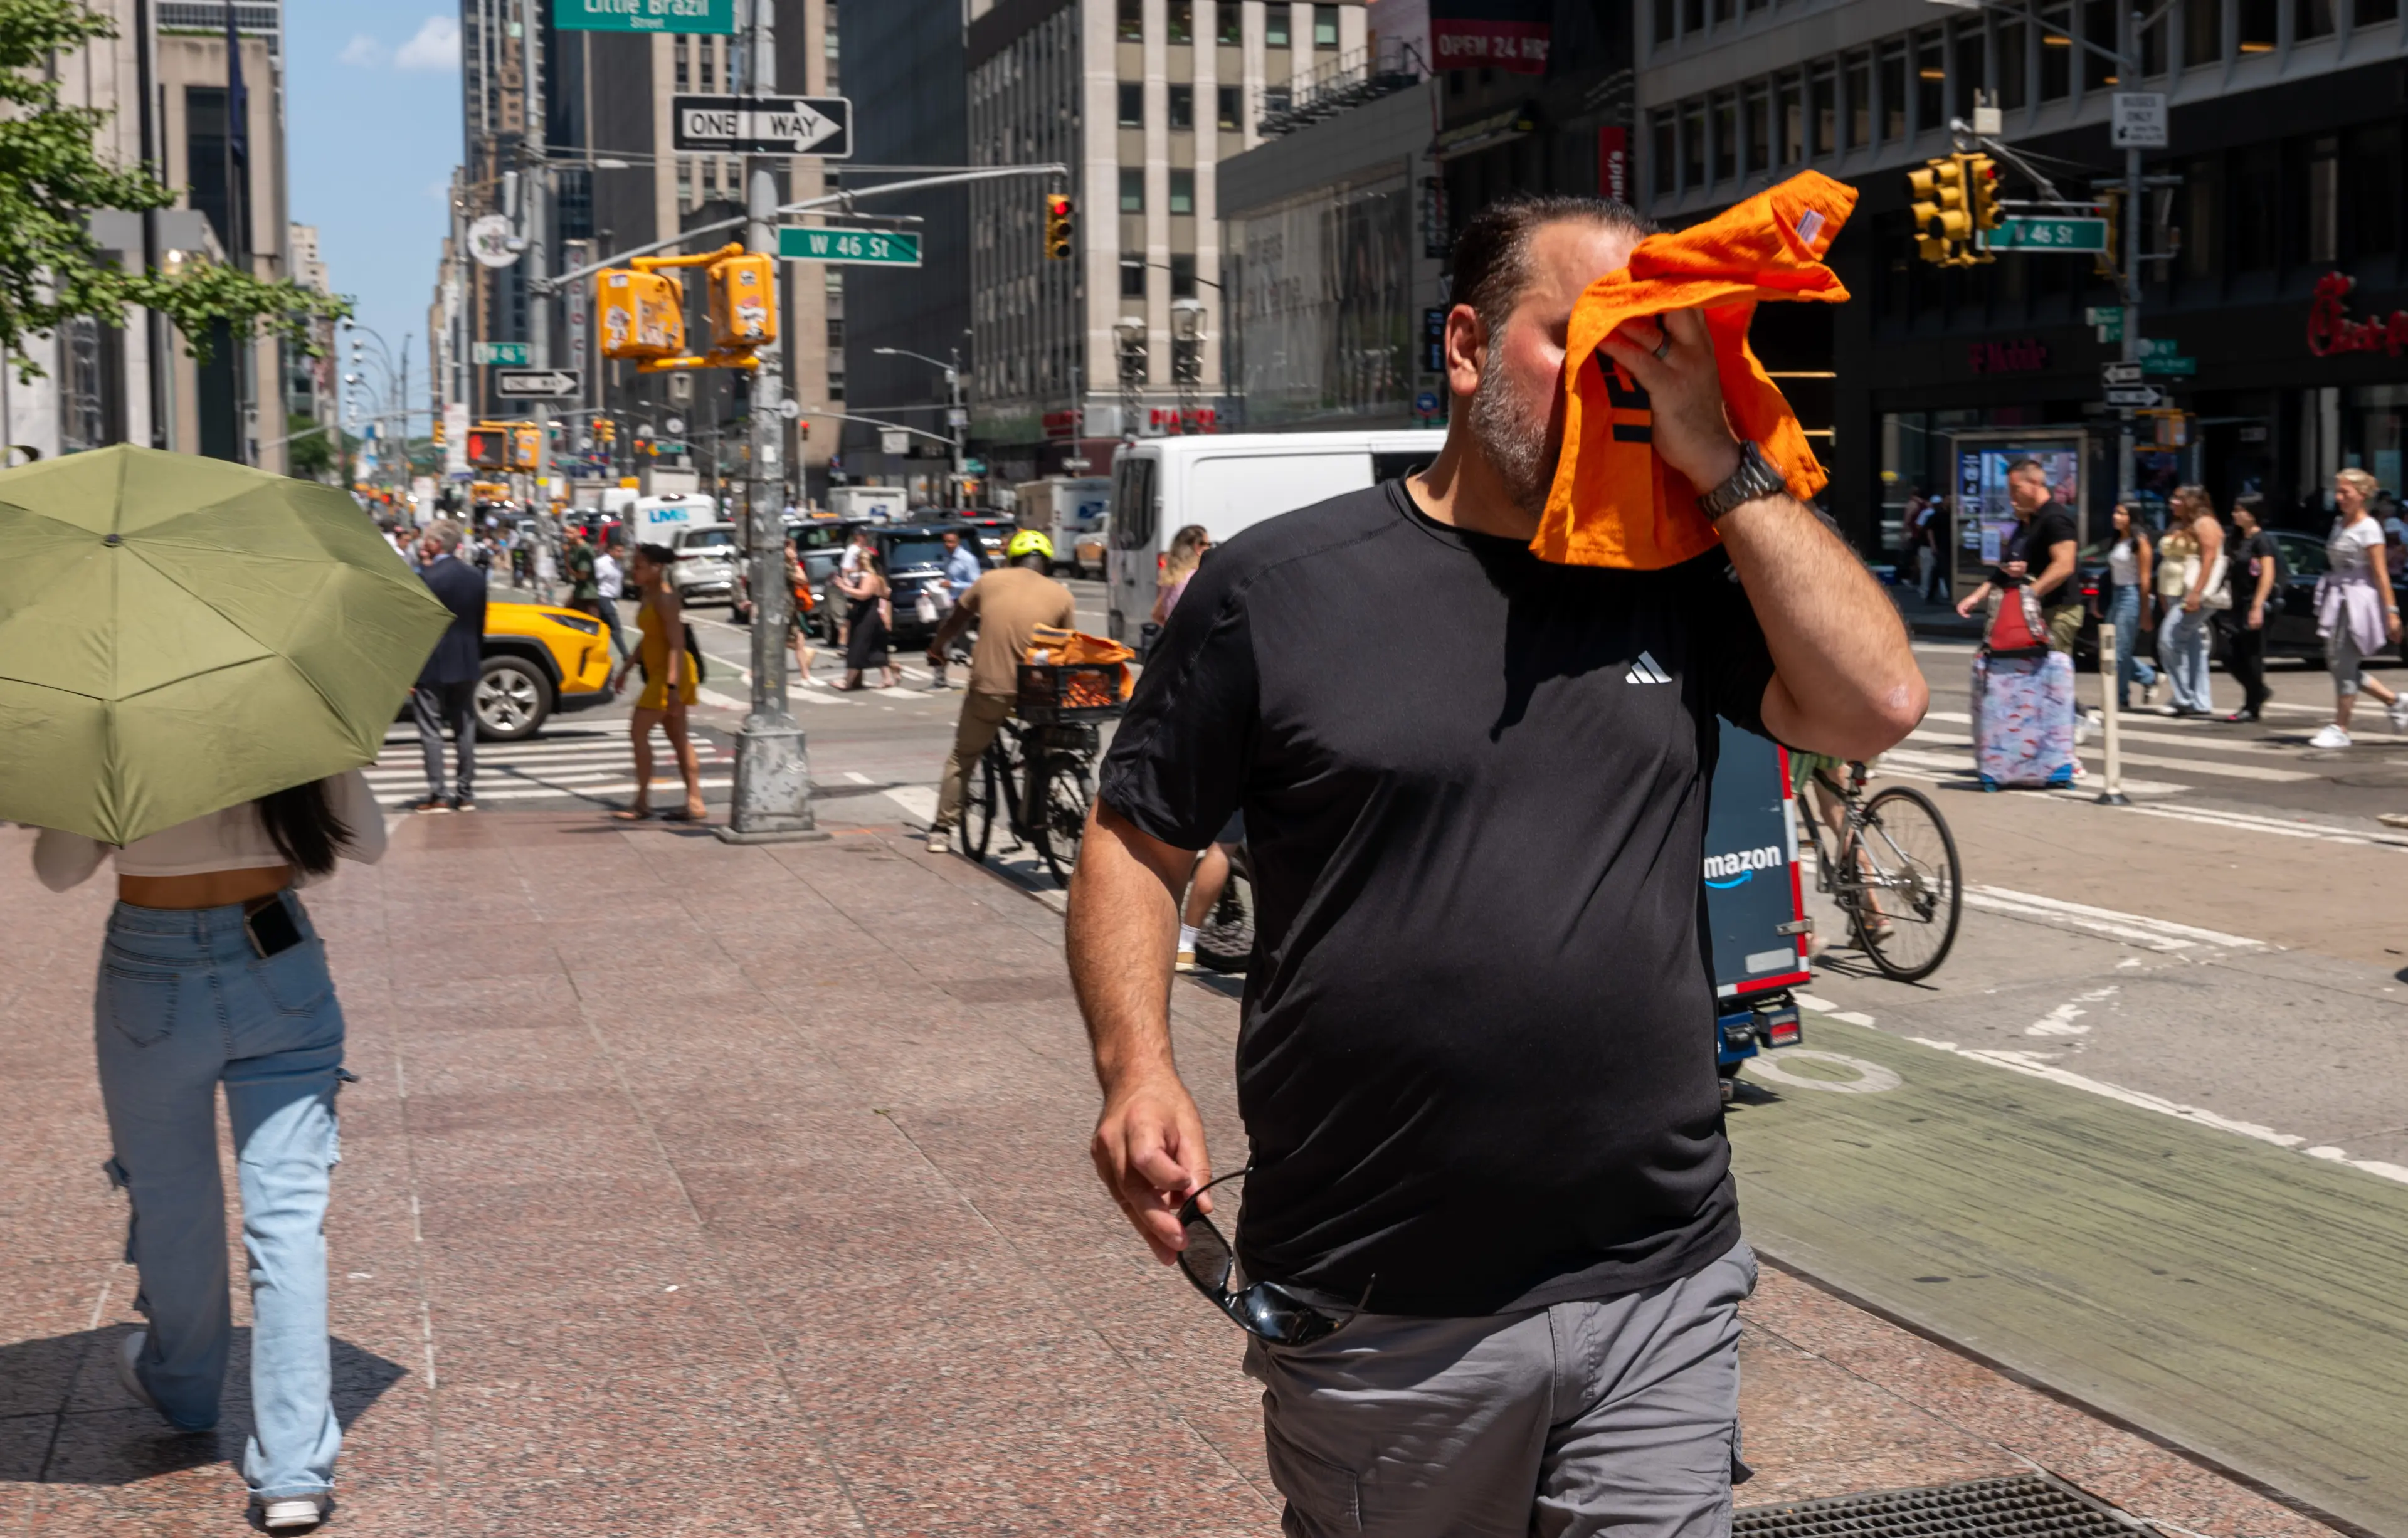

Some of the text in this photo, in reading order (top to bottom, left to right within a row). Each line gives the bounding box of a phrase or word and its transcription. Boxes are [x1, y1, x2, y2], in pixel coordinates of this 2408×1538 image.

[584, 0, 709, 16] Little Brazil
[630, 15, 665, 29] Street
[1437, 34, 1488, 56] OPEN
[1493, 36, 1517, 58] 24
[691, 113, 820, 137] ONE WAY
[809, 234, 889, 258] W 46 St
[2030, 224, 2052, 244] 46
[2056, 224, 2073, 244] St
[1704, 845, 1782, 878] mazon
